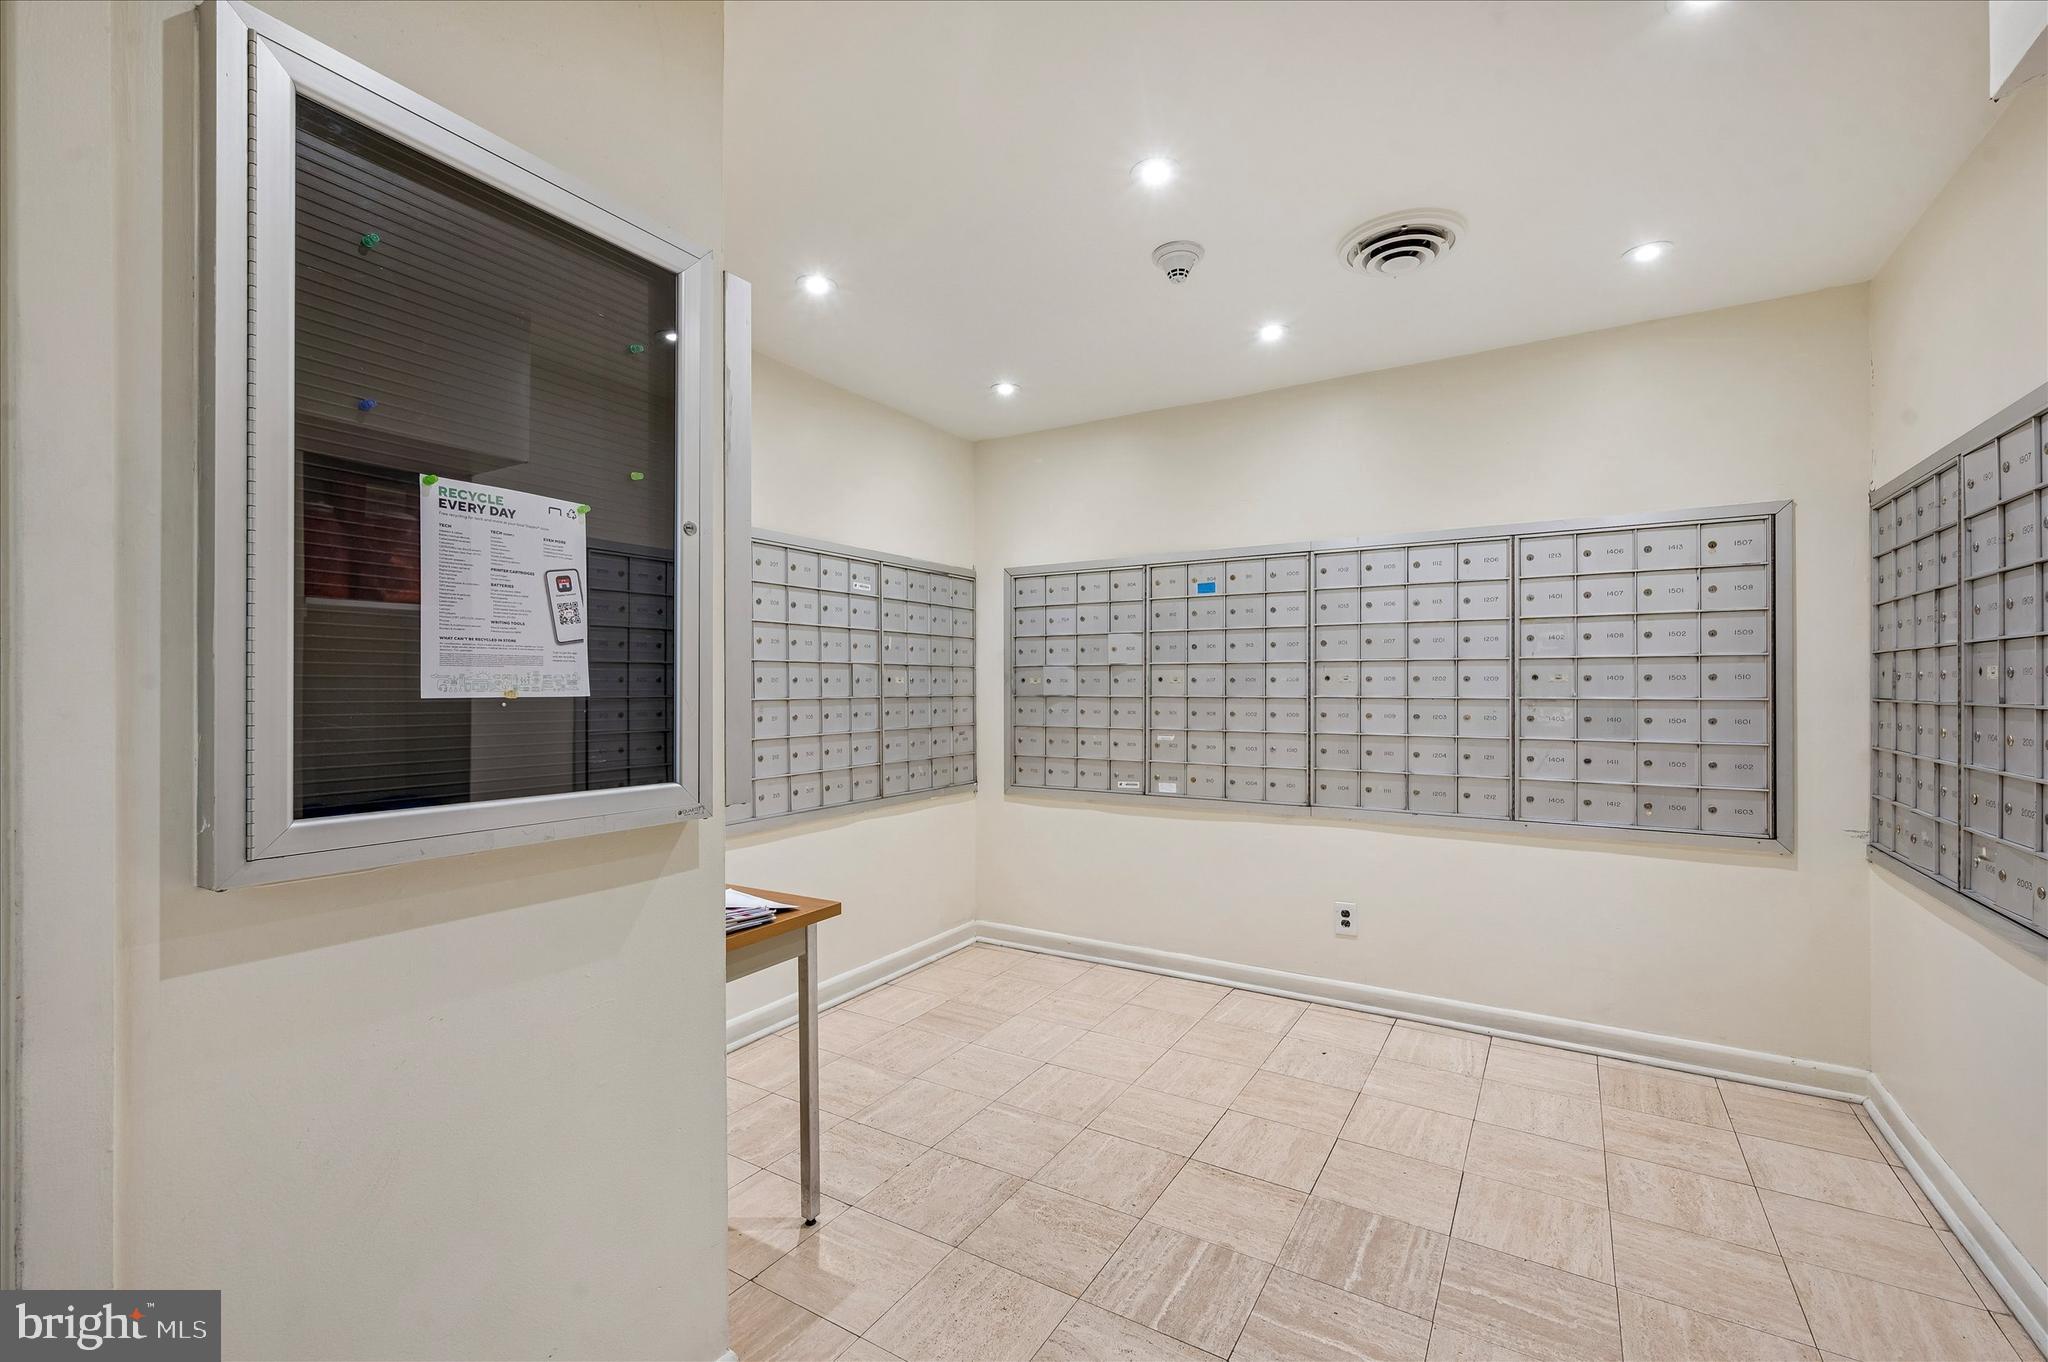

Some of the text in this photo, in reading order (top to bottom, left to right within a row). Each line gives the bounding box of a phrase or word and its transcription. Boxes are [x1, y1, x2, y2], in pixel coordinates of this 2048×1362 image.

[438, 486, 504, 506] RECYCLE
[438, 498, 516, 519] EVERY DAY
[2017, 879, 2033, 890] 2003
